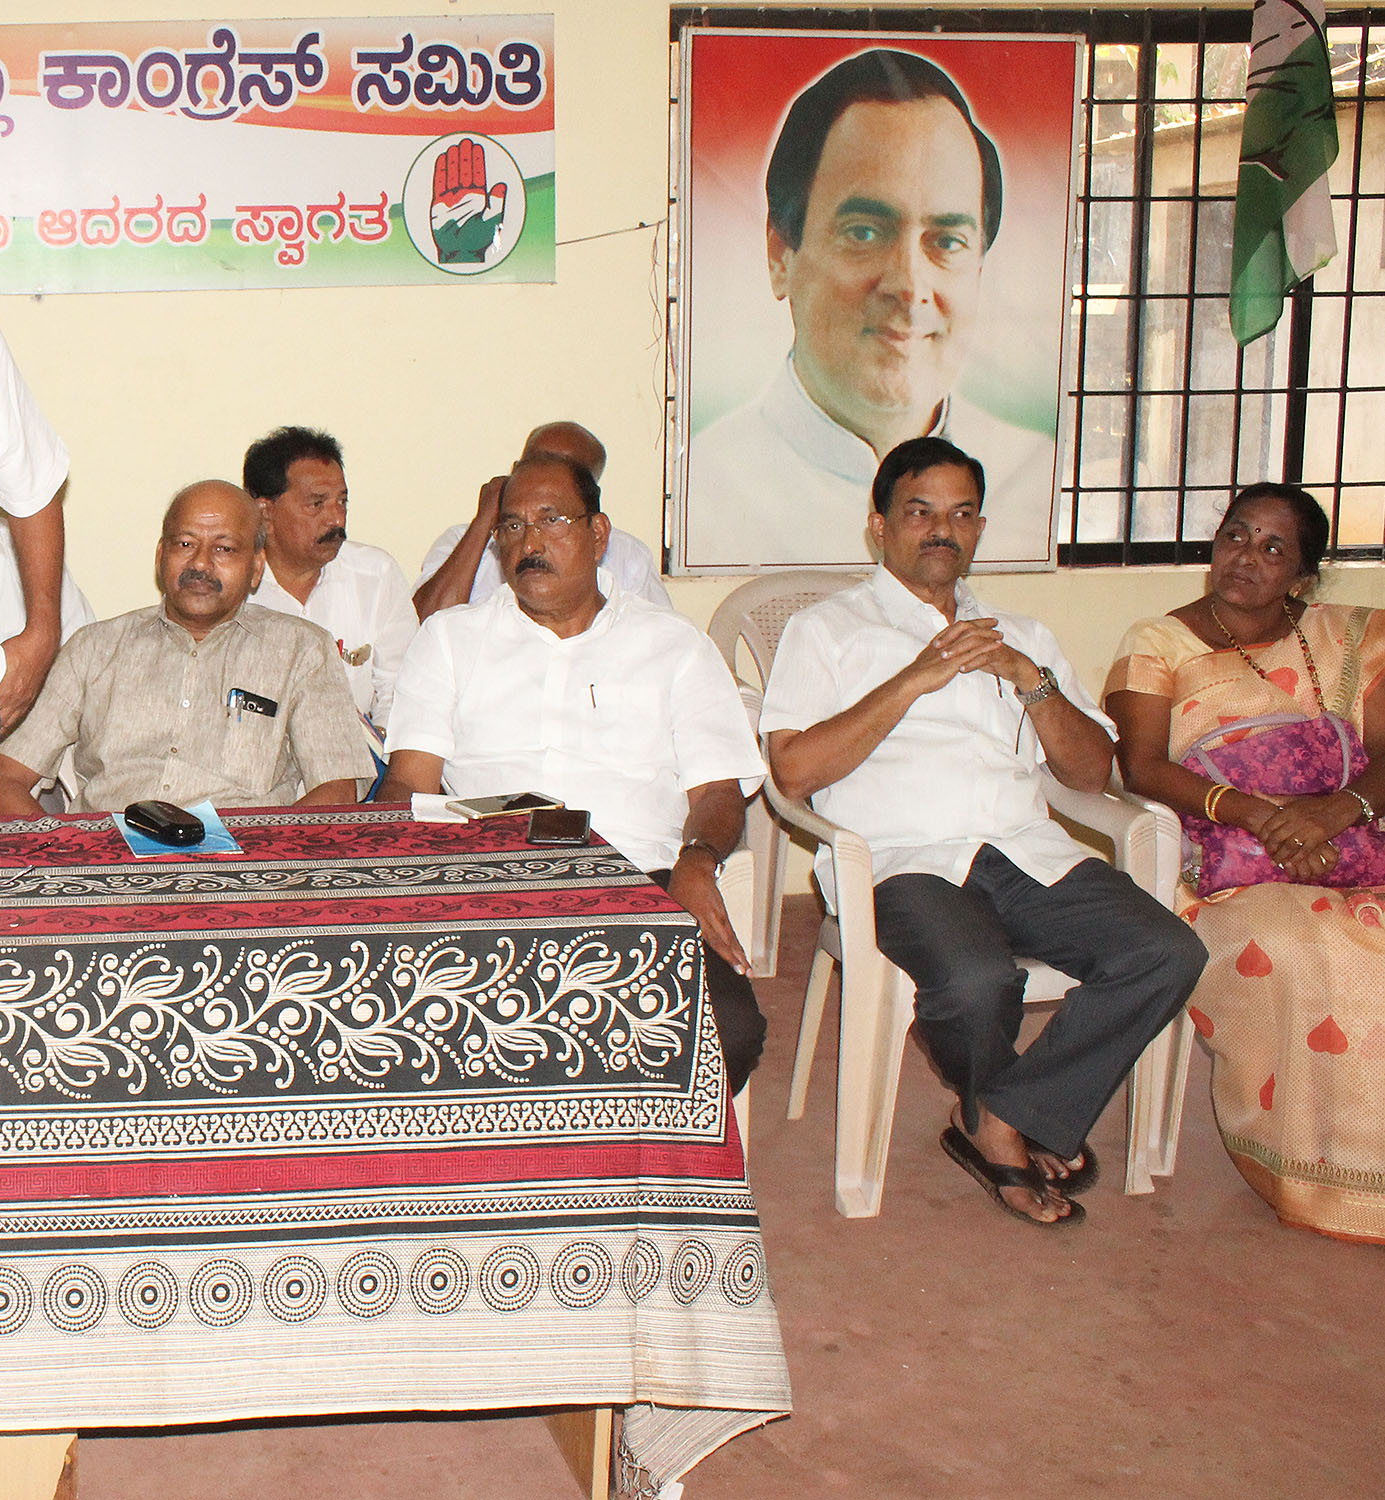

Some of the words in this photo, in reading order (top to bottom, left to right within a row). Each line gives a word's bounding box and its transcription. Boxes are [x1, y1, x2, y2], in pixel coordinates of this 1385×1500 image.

[43, 28, 320, 121] ಕಾಂಗ್ರೆಸ್
[355, 33, 542, 108] ಸಮಿತಿ
[38, 192, 207, 246] ಆದರದ
[234, 191, 390, 266] ಸ್ವಾಗತ
